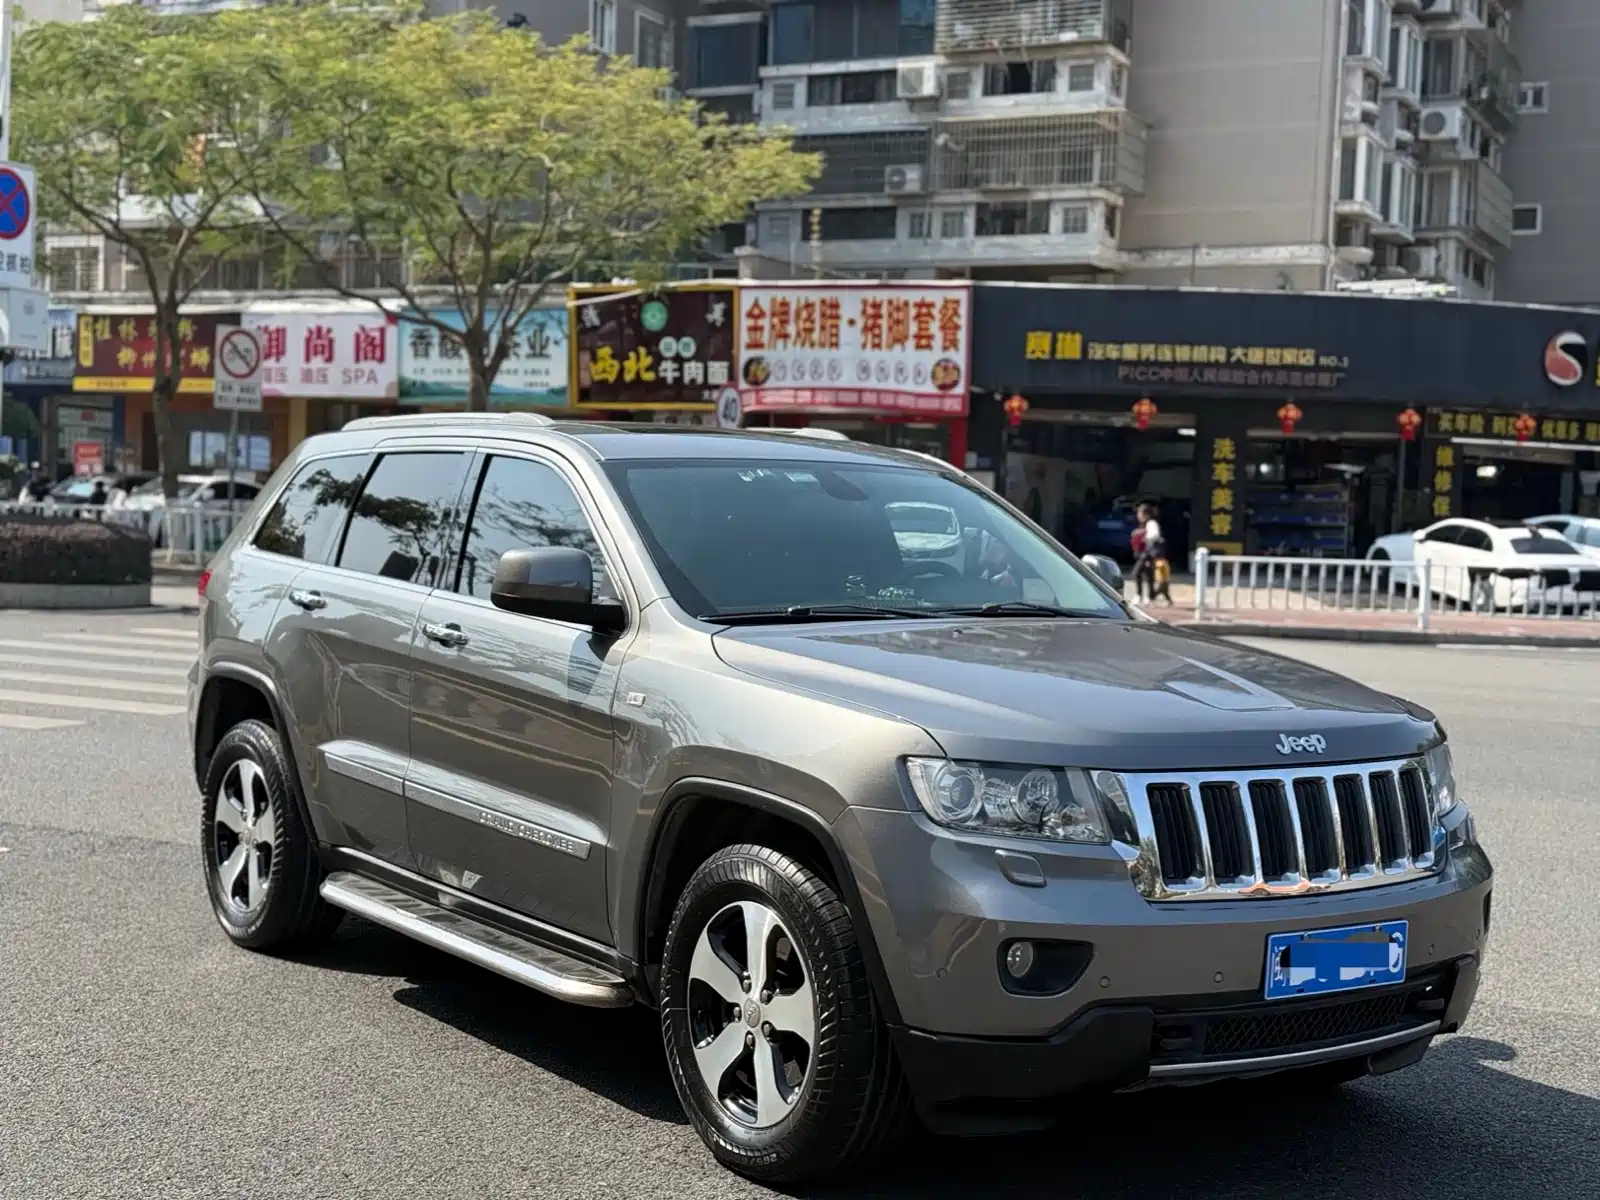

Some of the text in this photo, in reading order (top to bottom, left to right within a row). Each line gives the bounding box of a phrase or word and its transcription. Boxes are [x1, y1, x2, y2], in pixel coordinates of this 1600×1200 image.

[590, 345, 656, 384] 西北
[658, 360, 729, 385] 牛肉面
[341, 369, 379, 385] SPA
[1276, 733, 1327, 754] Jeep
